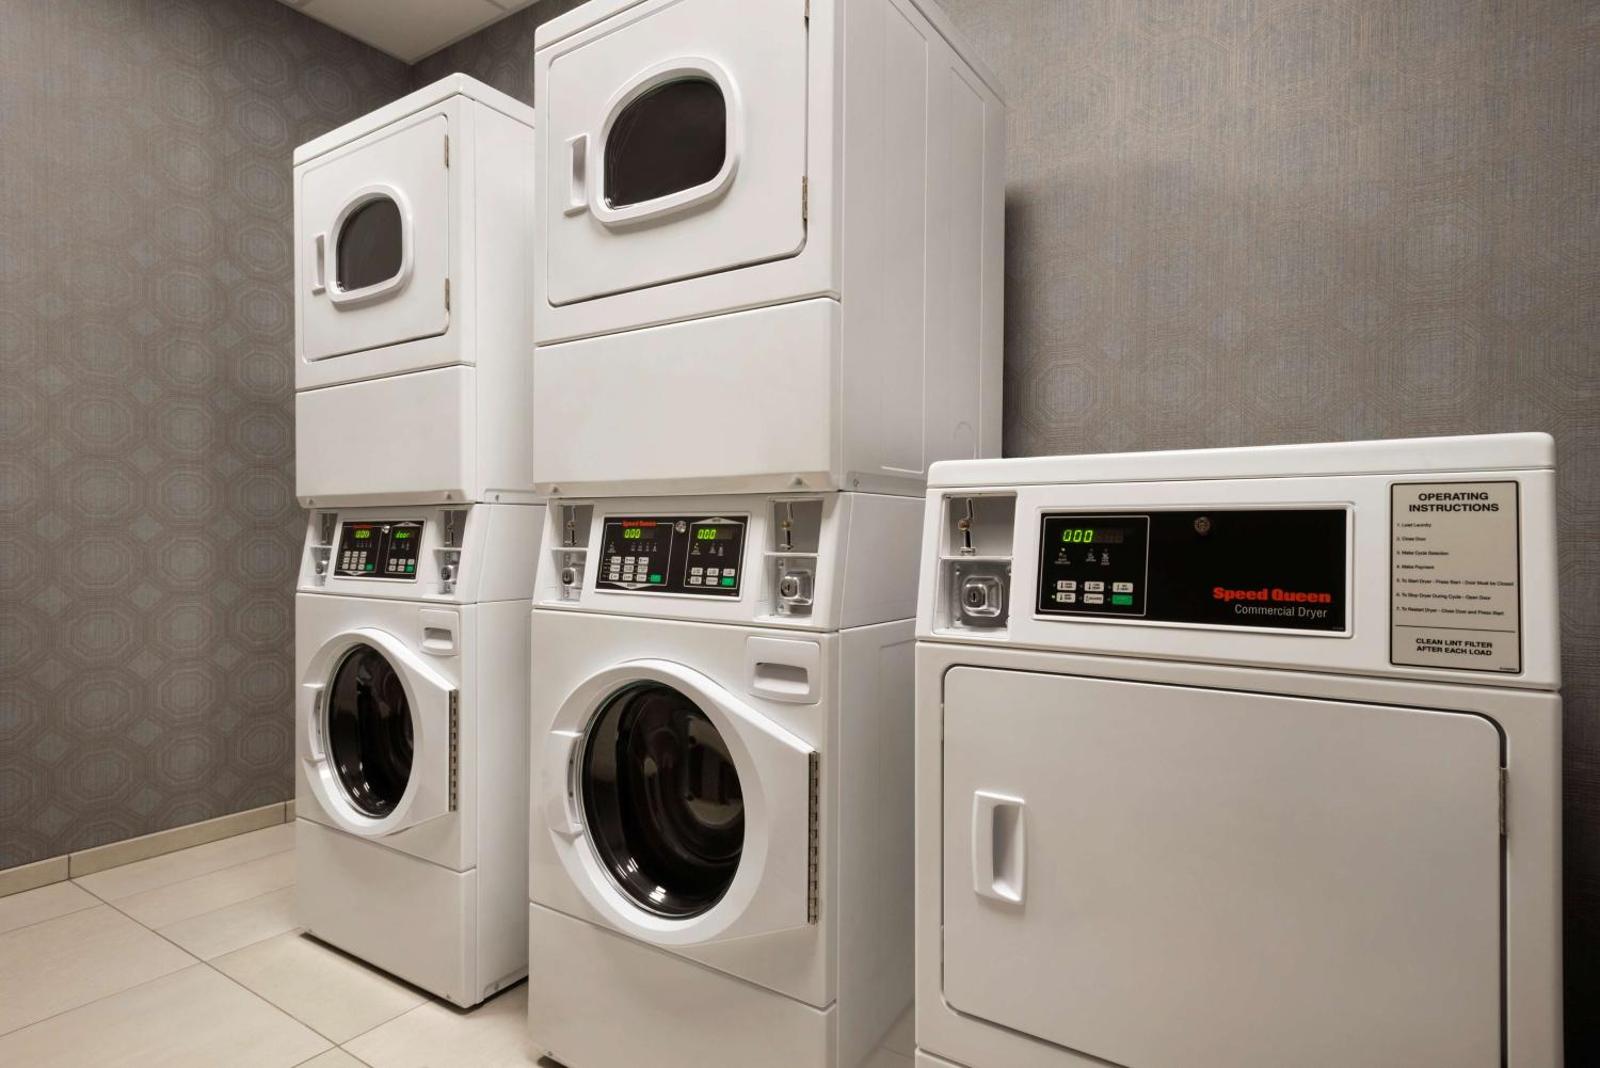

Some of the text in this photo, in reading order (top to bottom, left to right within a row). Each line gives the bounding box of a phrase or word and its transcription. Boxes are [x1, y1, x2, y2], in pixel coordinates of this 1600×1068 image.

[1418, 492, 1489, 501] OPERATING
[1408, 503, 1500, 512] INSTRUCTIONS
[624, 528, 641, 538] 000
[697, 528, 717, 540] 000
[1062, 529, 1093, 542] 000
[1212, 586, 1332, 603] Speed Queen
[1234, 604, 1328, 620] Commercial Dryer
[1464, 640, 1493, 648] FILTER
